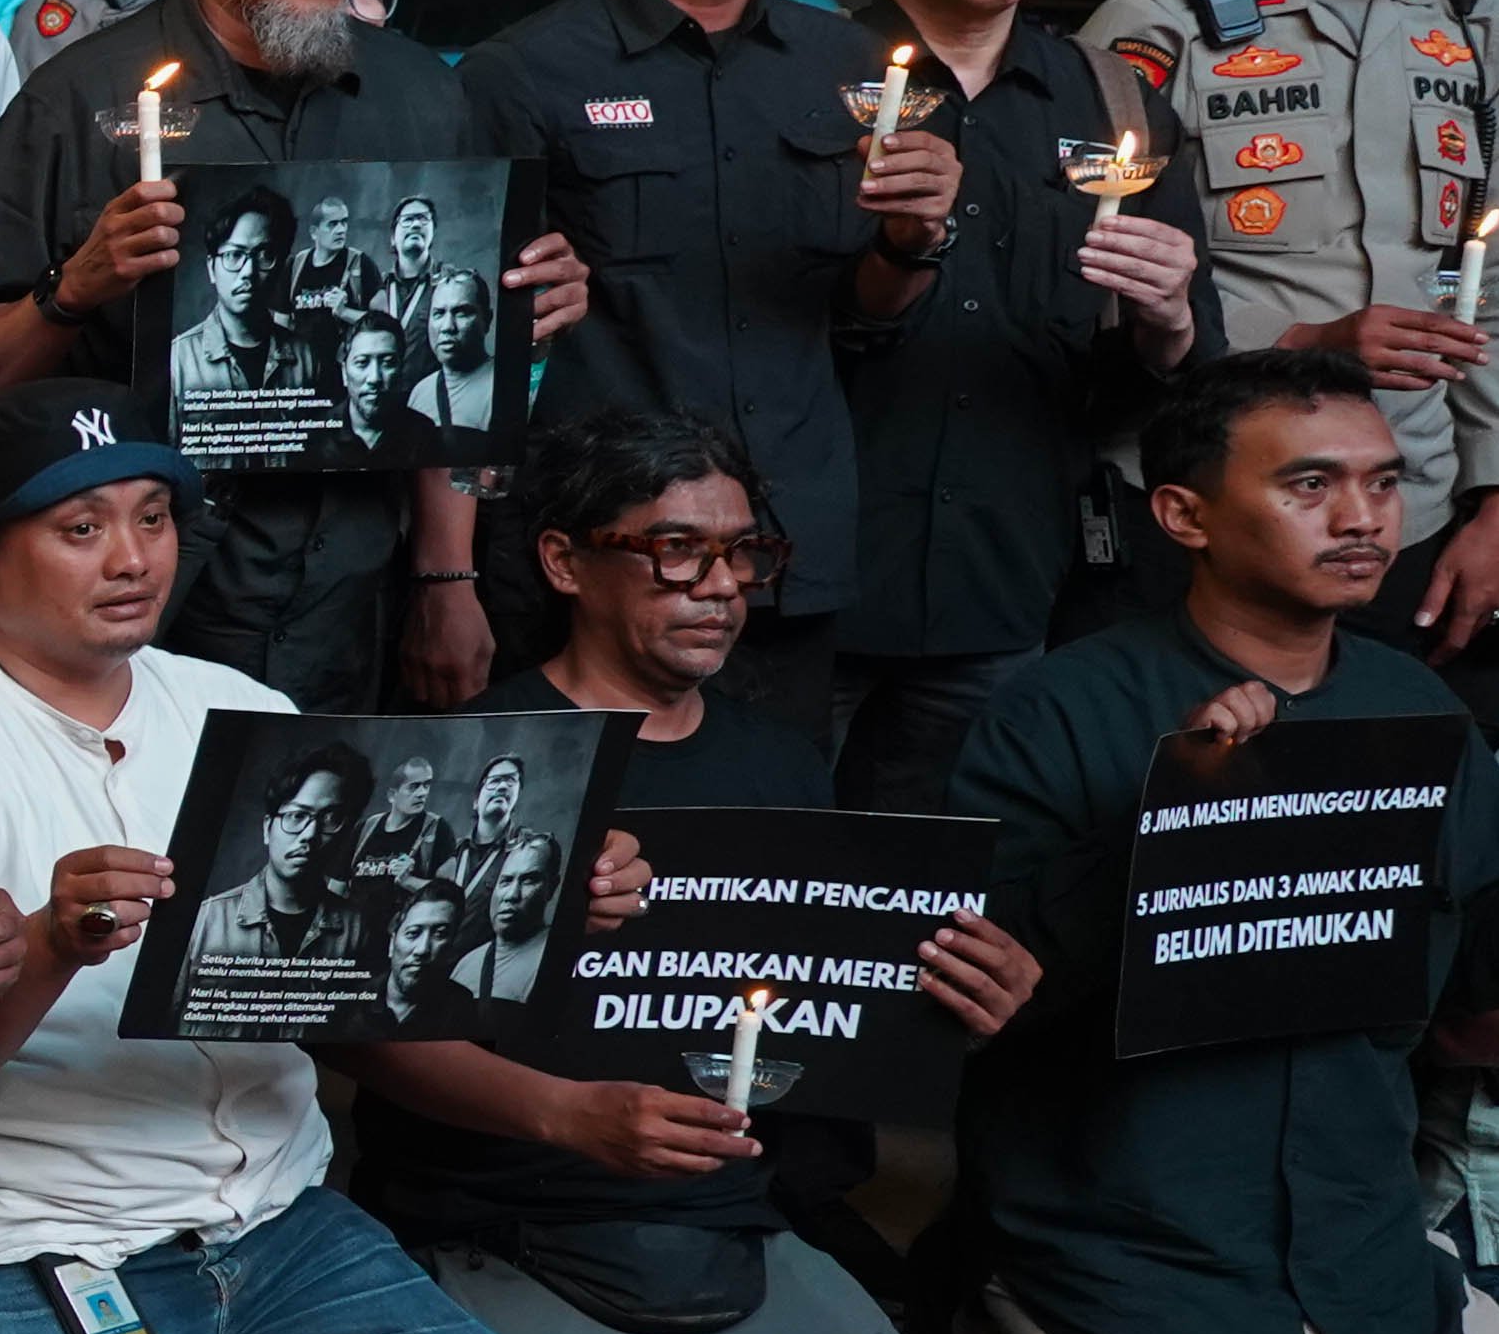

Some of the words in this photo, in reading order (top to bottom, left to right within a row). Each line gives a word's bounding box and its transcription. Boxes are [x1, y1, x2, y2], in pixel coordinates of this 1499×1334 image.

[589, 102, 649, 122] FOTO
[1206, 83, 1321, 120] BAHRI
[1140, 811, 1152, 834] 8
[1152, 805, 1190, 833] JIWA
[1192, 798, 1248, 827] MASIH
[1251, 789, 1371, 821] MENUNGGU
[1370, 785, 1446, 811] KABAR
[648, 876, 800, 904] HENTIKAN
[804, 881, 987, 918] PENCARIAN
[1136, 893, 1149, 916] 5
[1149, 880, 1230, 914] JURNALIS
[1232, 877, 1274, 903] DAN
[1277, 875, 1291, 898] 3
[1293, 869, 1355, 897] AWAK
[1358, 864, 1423, 891] KAPAL
[1154, 924, 1233, 965] BELUM
[1237, 909, 1394, 954] DITEMUKAN
[658, 951, 812, 982] BIARKAN
[593, 995, 862, 1040] DILUPAKAN
